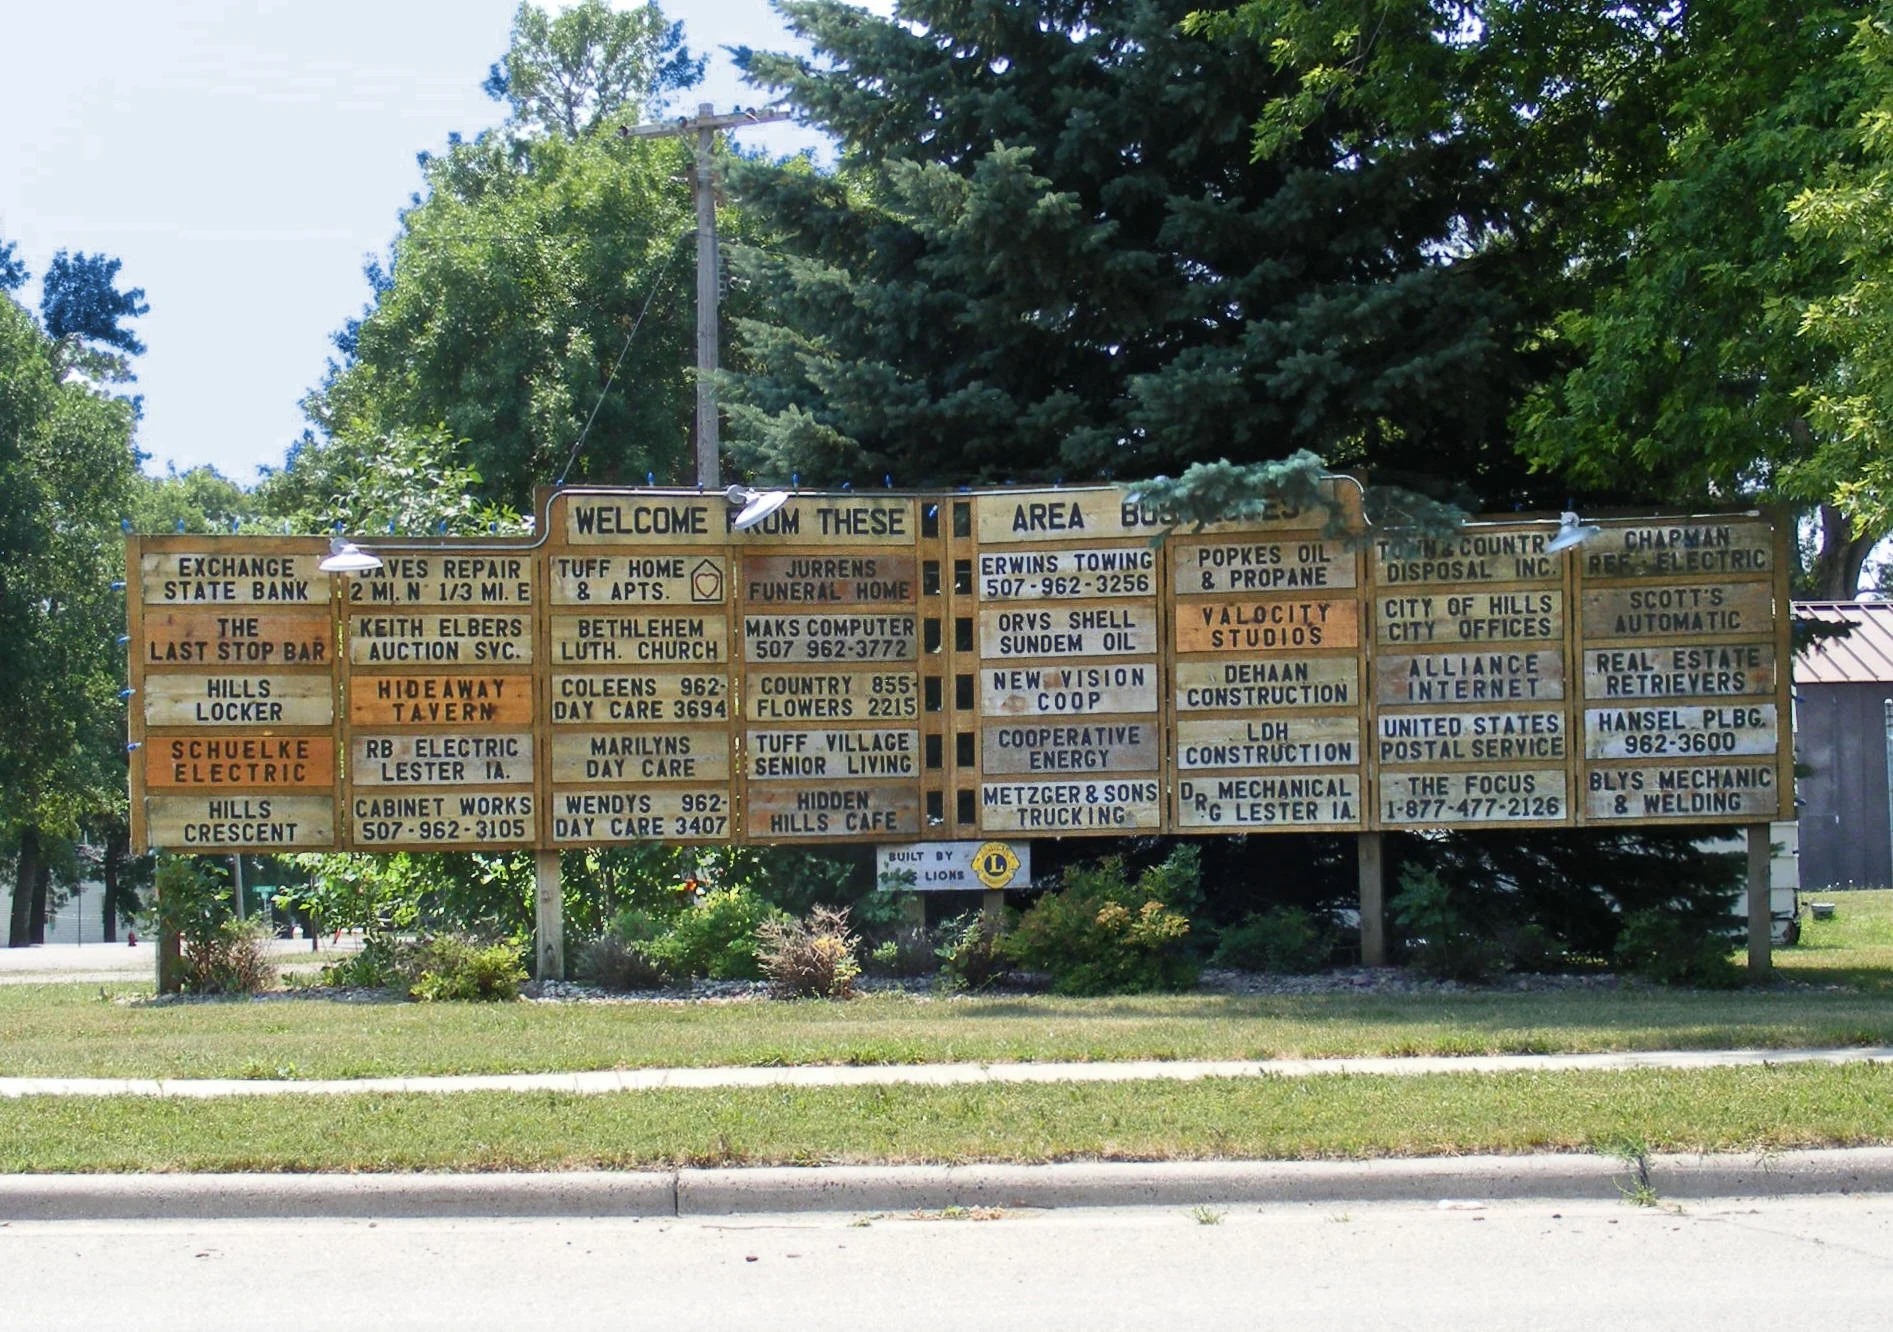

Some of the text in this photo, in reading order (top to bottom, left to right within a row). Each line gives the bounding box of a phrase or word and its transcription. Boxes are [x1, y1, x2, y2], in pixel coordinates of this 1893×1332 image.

[575, 506, 906, 535] WELCOME FOM THESE
[1012, 497, 1300, 531] AREA BUSES
[1624, 527, 1730, 549] CHAPMAN
[982, 551, 1153, 575] ERWINS TOWING
[1198, 545, 1331, 568] POPKES OIL
[1657, 549, 1766, 572] ELECTRIC
[178, 558, 295, 578] EXCHANGE
[444, 559, 520, 579] REPAIR
[560, 559, 685, 578] TUFF HOME
[785, 560, 876, 578] JURRENS
[1202, 567, 1328, 589] & PROPANE
[1387, 557, 1556, 581] DISPOSAL INC.
[165, 582, 308, 601] STATE BANK
[351, 582, 530, 603] 2 MI. N 1/3 MI. E
[577, 582, 670, 600] & APTS.
[750, 582, 910, 600] FUNERAL HOME
[987, 575, 1149, 597] 507-962-3256
[1385, 595, 1553, 618] CITY OF HILLS
[1630, 589, 1723, 609] SCOTT'S
[998, 609, 1135, 632] ORVS SHELL
[1202, 603, 1331, 626] VALOCITY
[1614, 610, 1741, 634] AUTOMATIC
[218, 618, 259, 638] THE
[360, 618, 522, 638] KEITH ELBERS
[579, 619, 704, 638] BETHLEHEM
[746, 618, 914, 637] MAKS COMPUTER
[1212, 626, 1322, 648] STUDIOS
[1389, 616, 1552, 640] CITY OFFICES
[151, 641, 325, 661] LAST STOP BAR
[369, 641, 521, 661] AUCTION SVC.
[562, 641, 717, 661] LUTH. CHURCH
[756, 639, 906, 659] 507 962-3772
[1000, 632, 1135, 654] SUNDEM OIL
[1409, 653, 1539, 676] ALLIANCE
[1597, 648, 1760, 672] REAL ESTATE
[994, 668, 1145, 690] NEW VISION
[1224, 664, 1309, 684] DEHAAN
[1607, 671, 1746, 695] RETRIEVERS
[207, 679, 271, 699] HILLS
[378, 679, 505, 700] HIDEAWAY
[561, 678, 726, 697] COLEENS 962-
[761, 676, 918, 695] COUNTRY 855-
[1187, 685, 1348, 707] CONSTRUCTION
[1408, 678, 1540, 700] INTERNET
[196, 702, 283, 721] LOCKER
[393, 702, 495, 722] TAVERN
[555, 700, 727, 719] DAY CARE 3694
[757, 697, 916, 717] FLOWERS 2215
[1038, 692, 1101, 711] COOP
[1384, 714, 1559, 737] UNITED STATES
[1599, 708, 1766, 731] HANSEL PLBG.
[998, 726, 1141, 747] COOPERATIVE
[1247, 722, 1288, 741] LDH
[172, 740, 309, 760] SCHUELKE
[366, 738, 518, 759] RB ELECTRIC
[591, 736, 690, 756] MARILYNS
[756, 733, 909, 752] TUFF VILLAGE
[1381, 736, 1564, 760] POSTAL SERVICE
[1625, 732, 1736, 754] 962-3600
[1030, 749, 1109, 770] ENERGY
[1186, 743, 1351, 765] CONSTRUCTION
[175, 763, 307, 783] ELECTRIC
[382, 760, 511, 781] LESTER IA.
[586, 758, 695, 778] DAY CARE
[755, 755, 912, 775] SENIOR LIVING
[1219, 778, 1351, 800] MECHANICAL
[1408, 774, 1536, 795] THE FOCUS
[1590, 767, 1772, 791] BLYS MECHANIC
[566, 794, 727, 813] WENDYS 962-
[797, 792, 869, 810] HIDDEN
[983, 782, 1158, 806] METZGER & SONS
[1614, 791, 1741, 814] & WELDING
[209, 800, 272, 819] HILLS
[356, 797, 532, 818] CABINET WORKS
[1018, 806, 1125, 826] TRUCKING
[1236, 801, 1356, 821] LESTER IA.
[1387, 796, 1560, 819] 1-877-477-2126
[184, 822, 297, 843] CRESCENT
[363, 819, 525, 840] 507-962-3105
[556, 816, 727, 836] DAY CARE 3407
[771, 812, 896, 833] HILLS CAFE
[889, 851, 953, 861] BUILT BY
[925, 871, 964, 881] LIONS
